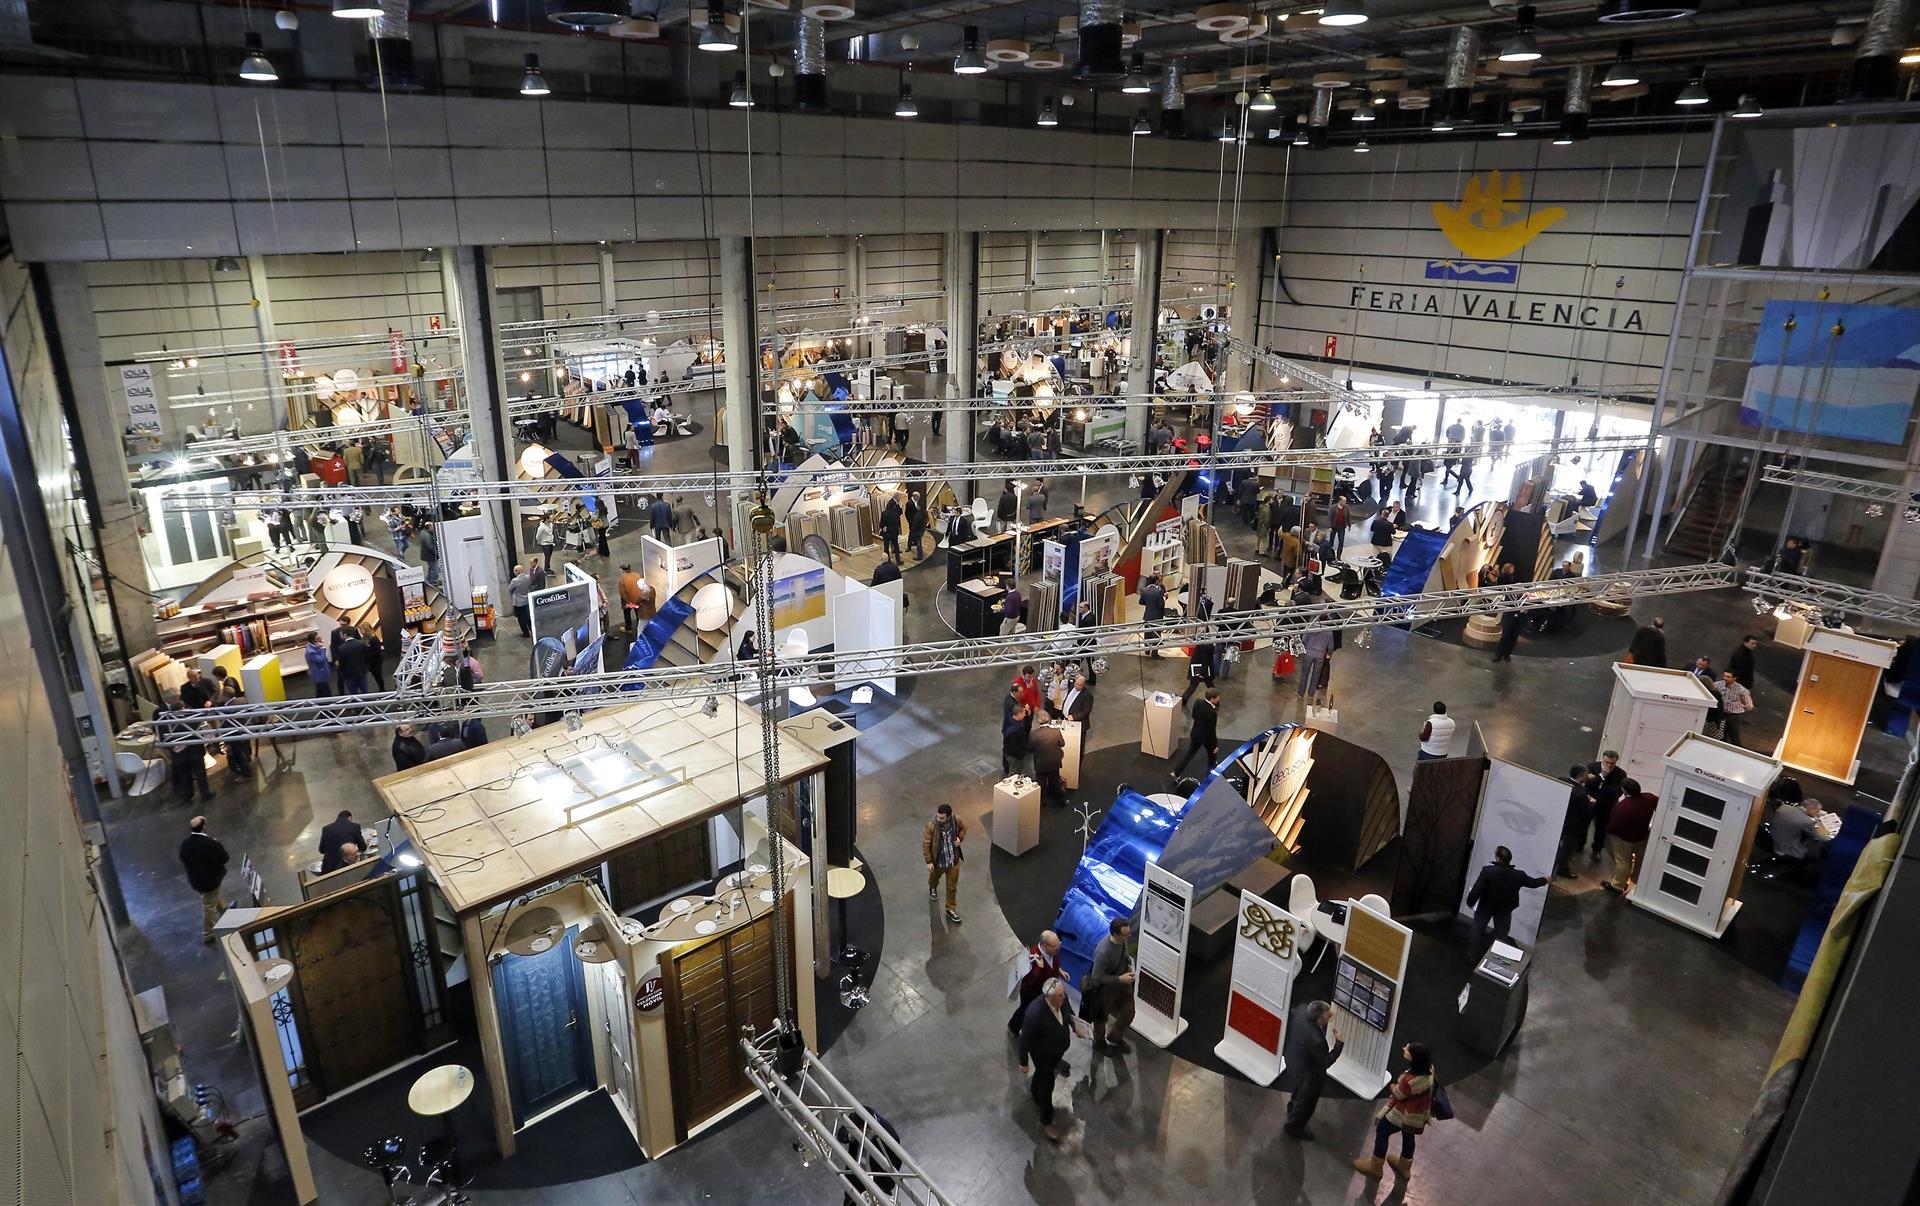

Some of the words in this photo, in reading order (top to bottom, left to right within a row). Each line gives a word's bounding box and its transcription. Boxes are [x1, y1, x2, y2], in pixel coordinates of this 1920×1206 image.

[1350, 286, 1439, 313] FERIA
[1462, 294, 1644, 330] VALENCIA
[536, 592, 567, 605] Grosfillex
[1703, 771, 1725, 782] NORMA
